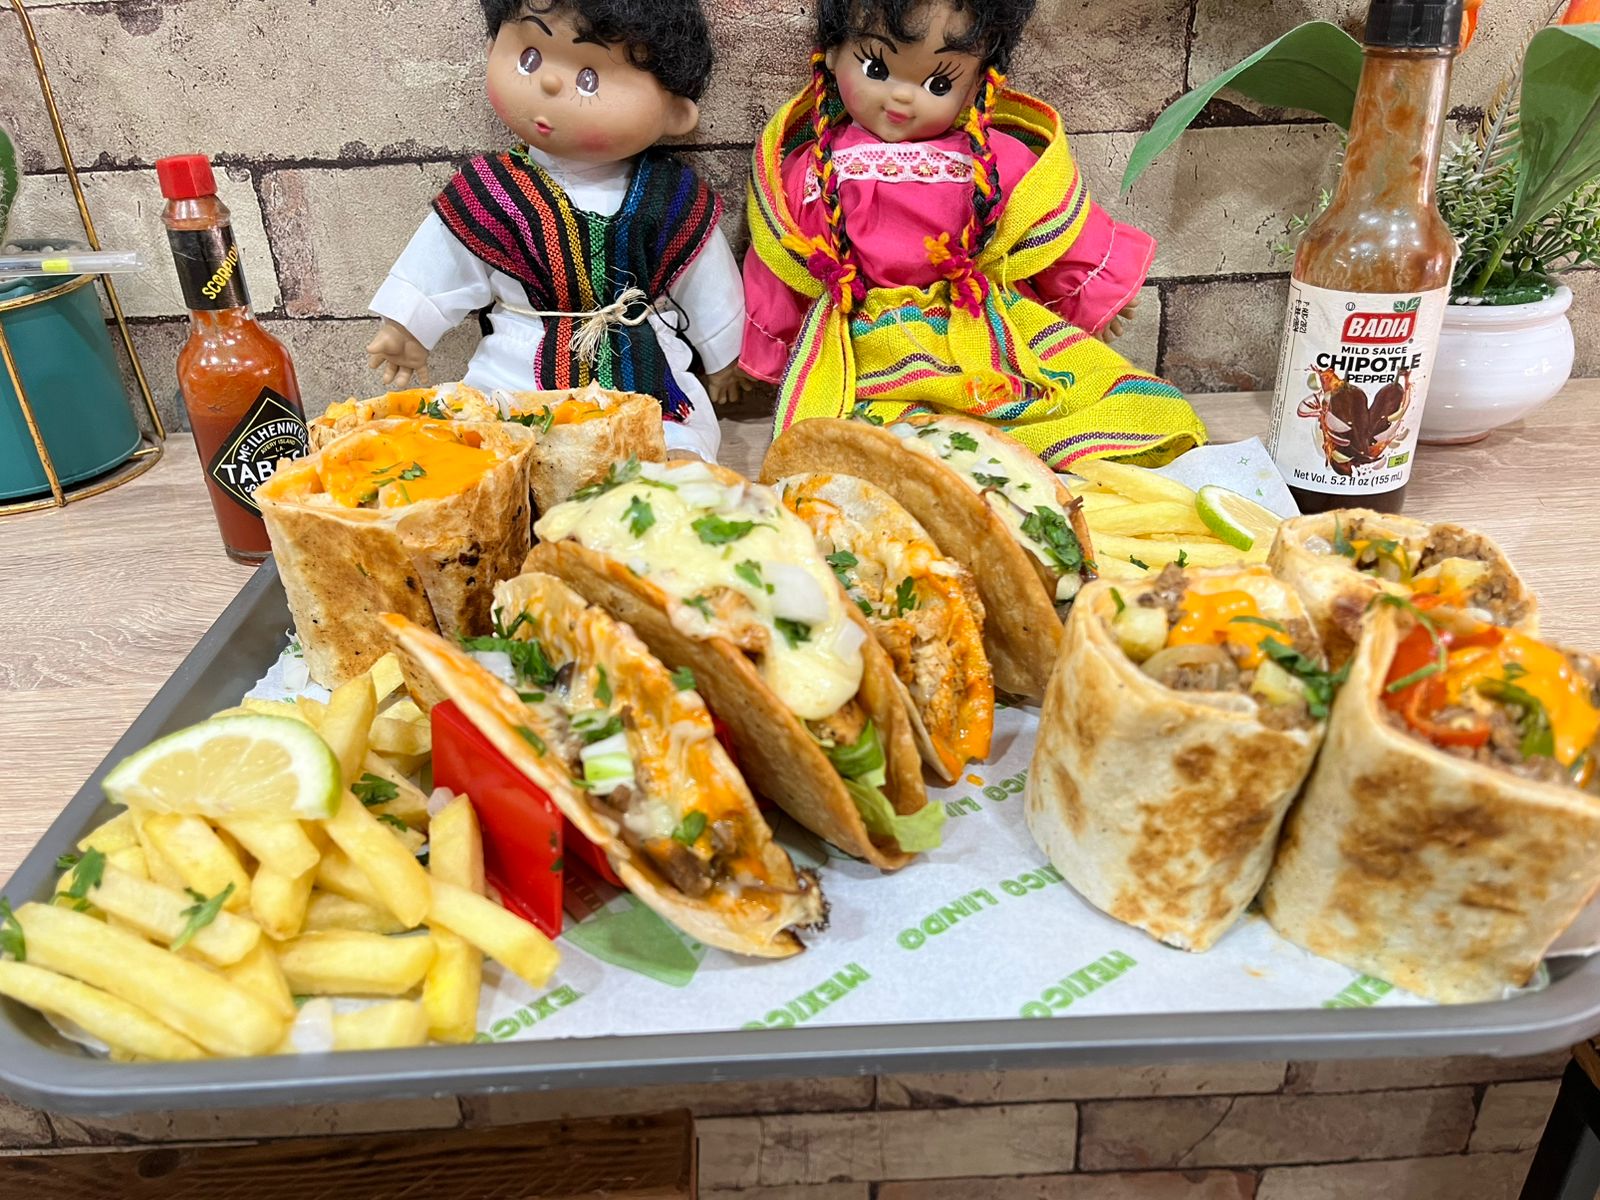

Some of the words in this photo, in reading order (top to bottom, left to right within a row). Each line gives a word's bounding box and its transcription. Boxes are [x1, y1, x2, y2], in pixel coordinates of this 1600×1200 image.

[1346, 317, 1411, 338] BADIA
[1341, 346, 1369, 355] MILD
[1372, 346, 1408, 355] SAUCE
[1316, 352, 1422, 373] CHIPOTLE
[1347, 373, 1395, 384] PEPPER
[260, 440, 278, 455] AVERY
[277, 438, 297, 447] ISLAND
[1293, 468, 1309, 481] Net
[1311, 472, 1328, 483] Vol.
[1330, 475, 1347, 486] 5.2
[1357, 477, 1369, 486] oz
[1370, 474, 1390, 487] (155
[896, 888, 999, 950] LINDO
